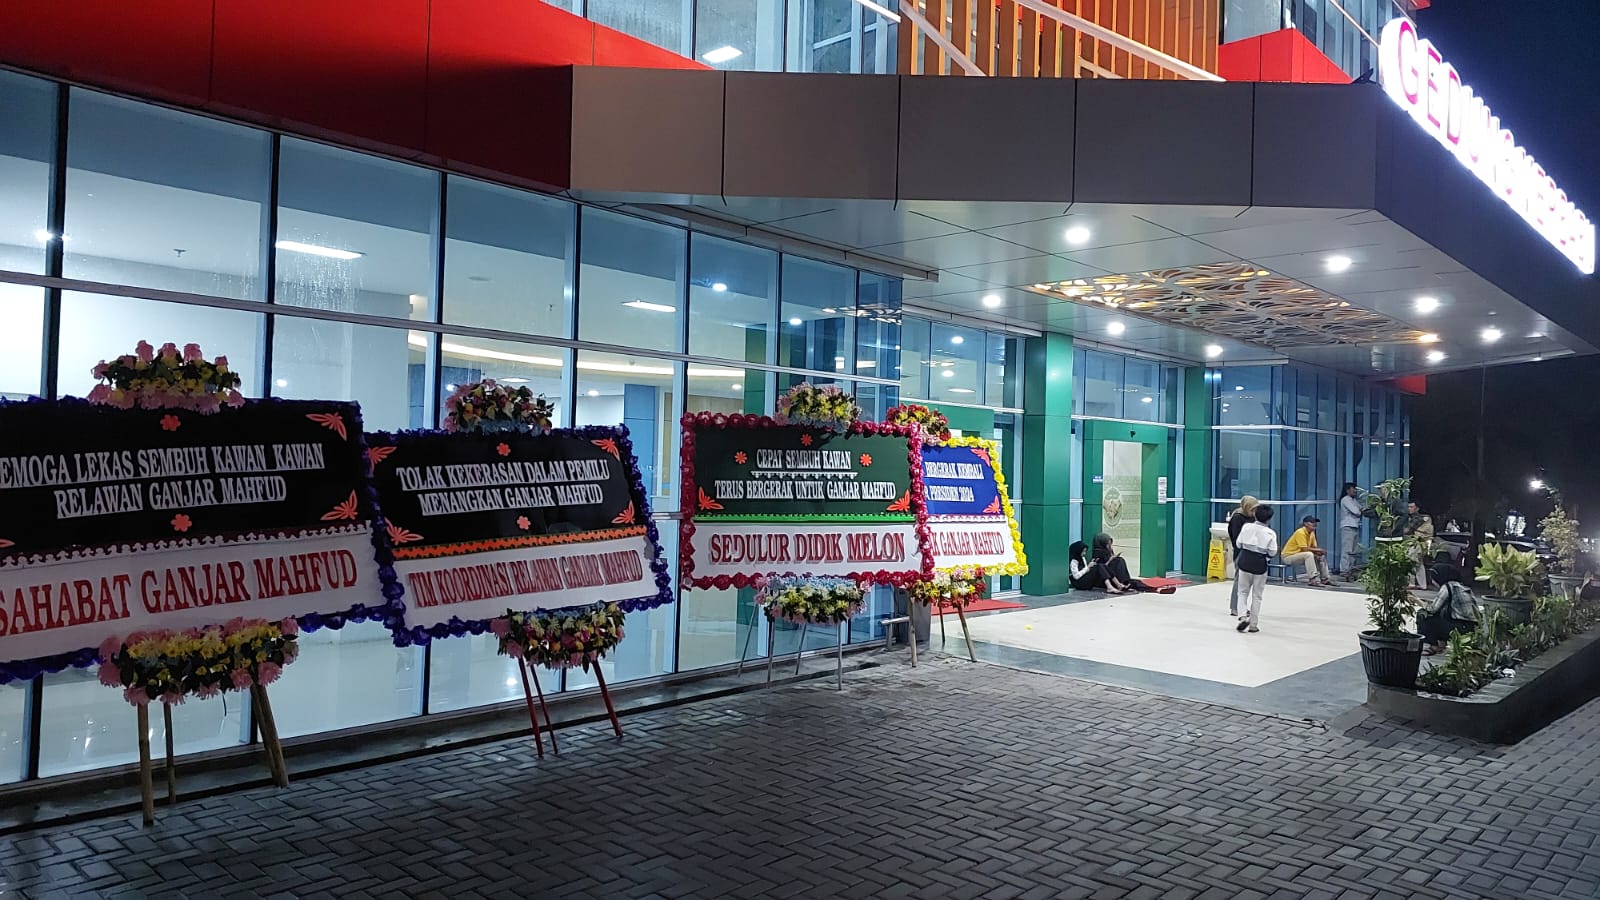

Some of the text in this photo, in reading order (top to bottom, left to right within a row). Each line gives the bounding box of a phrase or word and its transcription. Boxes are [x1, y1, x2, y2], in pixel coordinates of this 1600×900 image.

[0, 443, 325, 488] EMOGA LEKAS SEMBUH KAWAN KAWAN
[396, 459, 610, 491] TOLAK KEKERASAN DALAM PEMILU
[756, 449, 851, 470] CEPAT SEMBUH KAWAN
[54, 475, 287, 519] RELAWAN GANJAR MAHFUD
[417, 483, 603, 516] MENANGKAN GANJAR MAHFUD
[714, 480, 896, 500] TERUS BERGERAK UNTUK GANJAR MAHFUD
[711, 533, 905, 563] SEDULUR DIDIK MELON
[940, 531, 973, 556] GANJAR
[970, 531, 1005, 556] MAHFUD
[141, 561, 250, 614] GANJAR
[254, 549, 357, 599] MAHFUD
[408, 549, 643, 608] TIM KOORDINASI RELAWAN GANJAR MAHFUD
